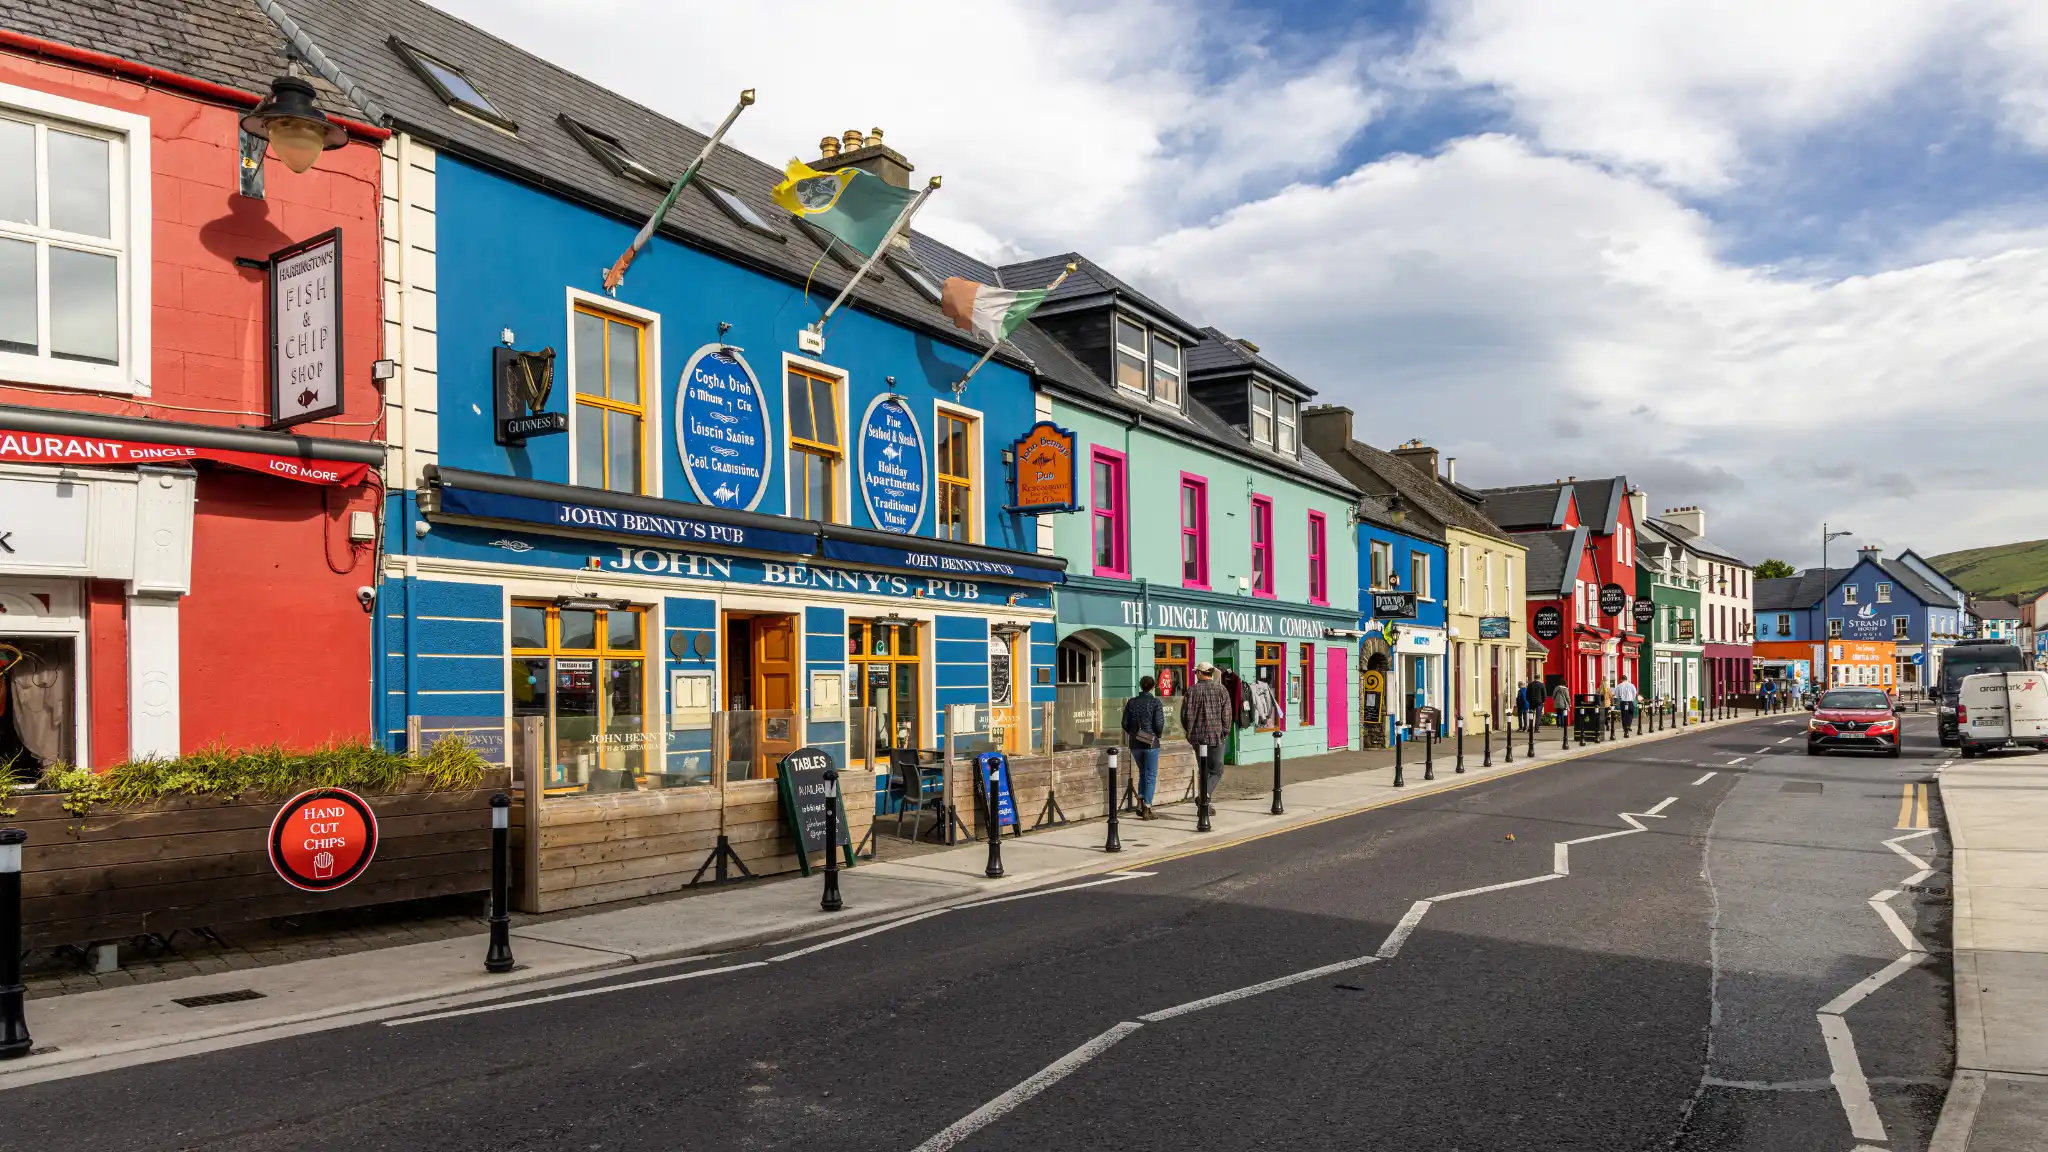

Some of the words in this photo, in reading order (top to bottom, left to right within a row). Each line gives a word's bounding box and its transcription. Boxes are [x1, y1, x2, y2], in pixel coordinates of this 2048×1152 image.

[279, 250, 333, 282] HARRINGTON'S
[286, 276, 327, 311] FISH
[303, 309, 311, 327] &
[285, 326, 328, 359] CHIP
[291, 361, 323, 385] SHOP
[508, 416, 551, 433] GUINNESS
[886, 414, 901, 429] Fine
[868, 423, 891, 442] Seafood
[891, 431, 897, 443] &
[898, 431, 917, 447] Steaks
[0, 435, 123, 459] AURANT
[129, 447, 197, 459] DINGLE
[269, 459, 298, 475] LOTS
[878, 460, 908, 480] Holiday
[865, 471, 920, 492] Apartments
[1035, 471, 1055, 484] Pub
[874, 496, 917, 514] Traditional
[560, 505, 617, 530] JOHN
[622, 512, 707, 539] BENNY'S
[710, 526, 744, 544] PUB
[884, 511, 907, 526] Music
[905, 552, 938, 569] JOHN
[940, 557, 992, 574] BENNY'S
[991, 563, 1014, 576] PUB
[610, 547, 733, 579] JOHN
[762, 563, 908, 595] BENNY'S
[926, 579, 980, 600] PUB
[1158, 604, 1209, 630] DINGLE
[1216, 610, 1273, 635] WOOLLEN
[1279, 616, 1324, 639] COMPANY
[1848, 618, 1887, 628] STRAND
[1979, 683, 2021, 693] aramark
[588, 733, 622, 744] JOHN
[791, 755, 827, 772] TABLES
[303, 807, 345, 820] HAND
[309, 822, 339, 834] CUT
[303, 837, 345, 850] CHIPS
